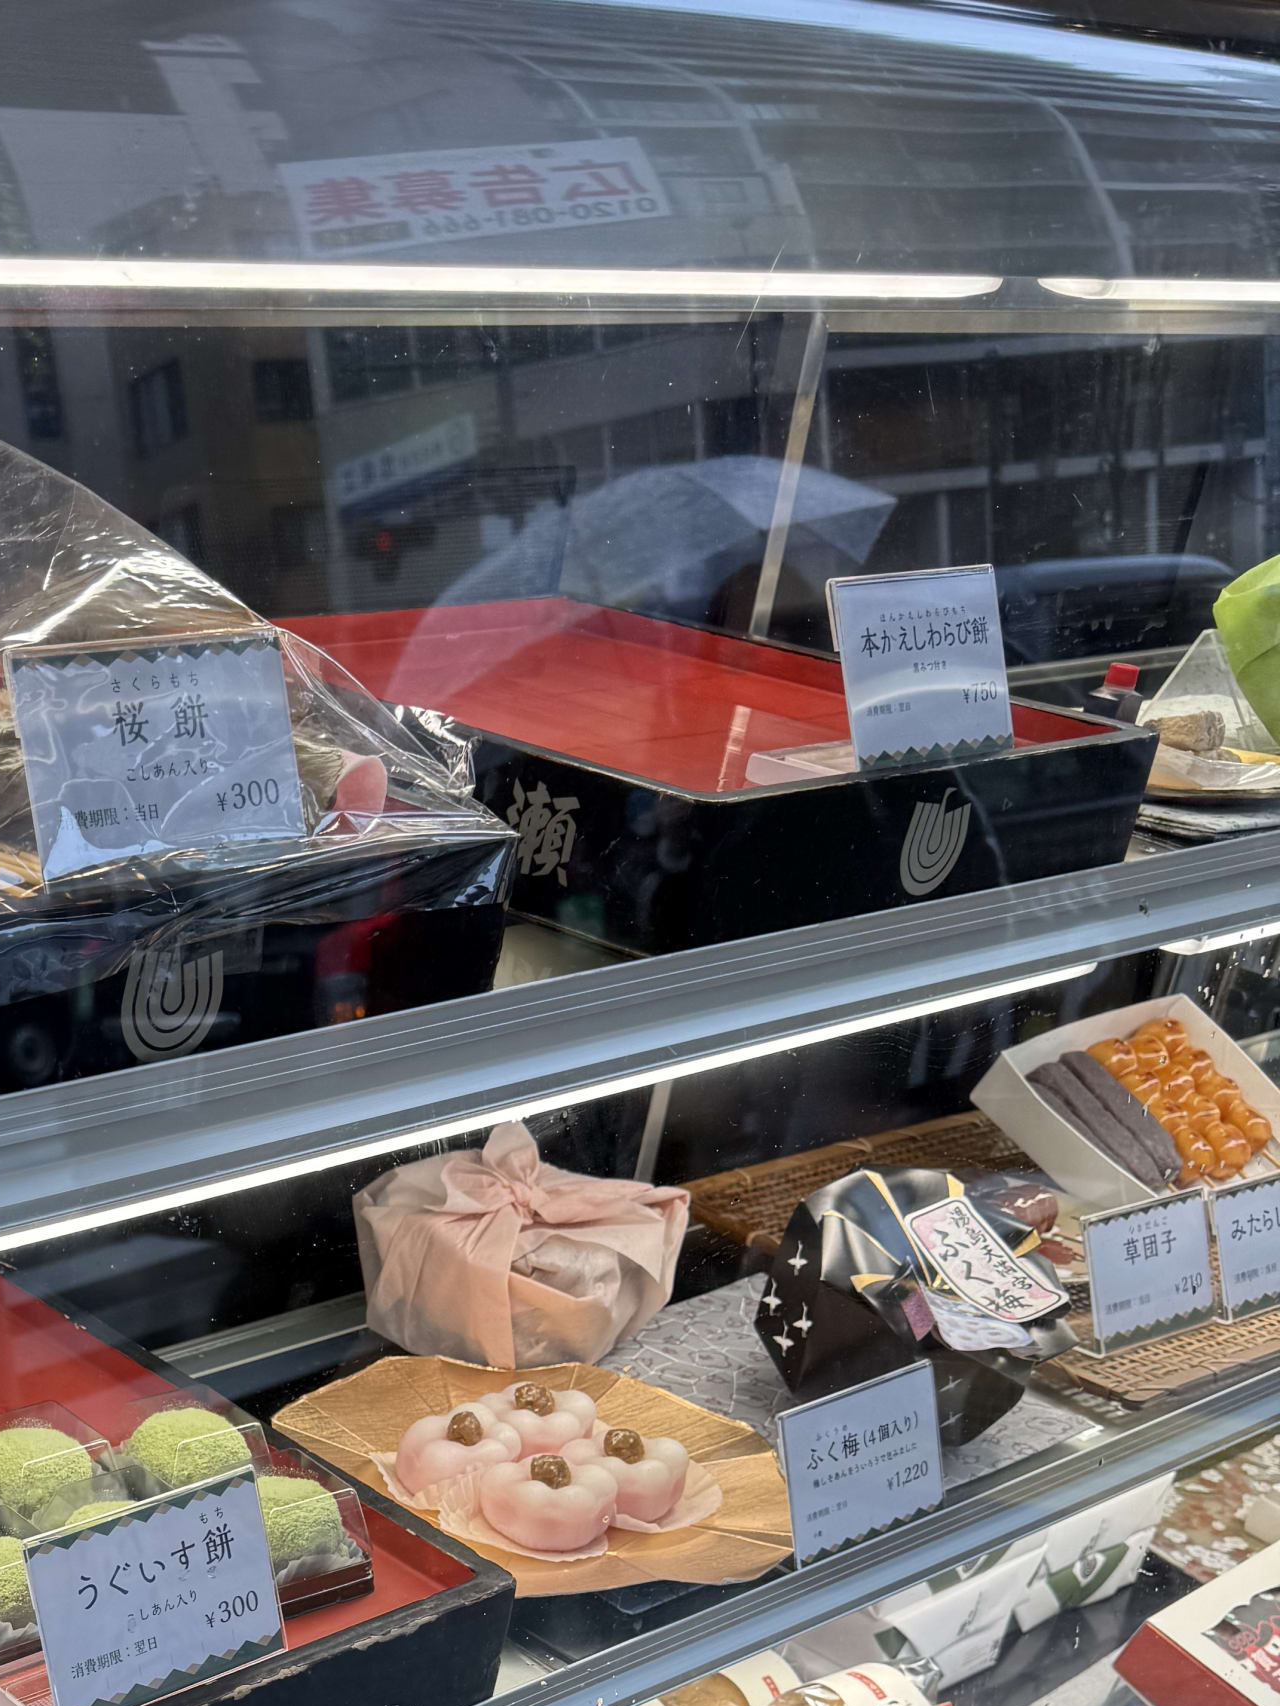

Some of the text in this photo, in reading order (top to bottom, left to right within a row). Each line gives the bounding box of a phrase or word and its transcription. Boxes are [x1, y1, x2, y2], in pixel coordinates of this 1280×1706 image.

[861, 616, 989, 658] 本かえしわらび餅
[110, 671, 199, 693] さくらもち
[962, 681, 997, 704] ¥750
[112, 694, 208, 746] 桜餅
[126, 758, 210, 782] こしあん入り
[216, 778, 279, 812] ¥300
[1123, 1230, 1177, 1265] 草団子
[886, 1460, 928, 1491] ¥1,220
[199, 1507, 224, 1524] もち
[78, 1523, 235, 1610] うぐいす餅
[205, 1590, 259, 1628] ¥300
[71, 1637, 158, 1680] 消費期限：翌日
